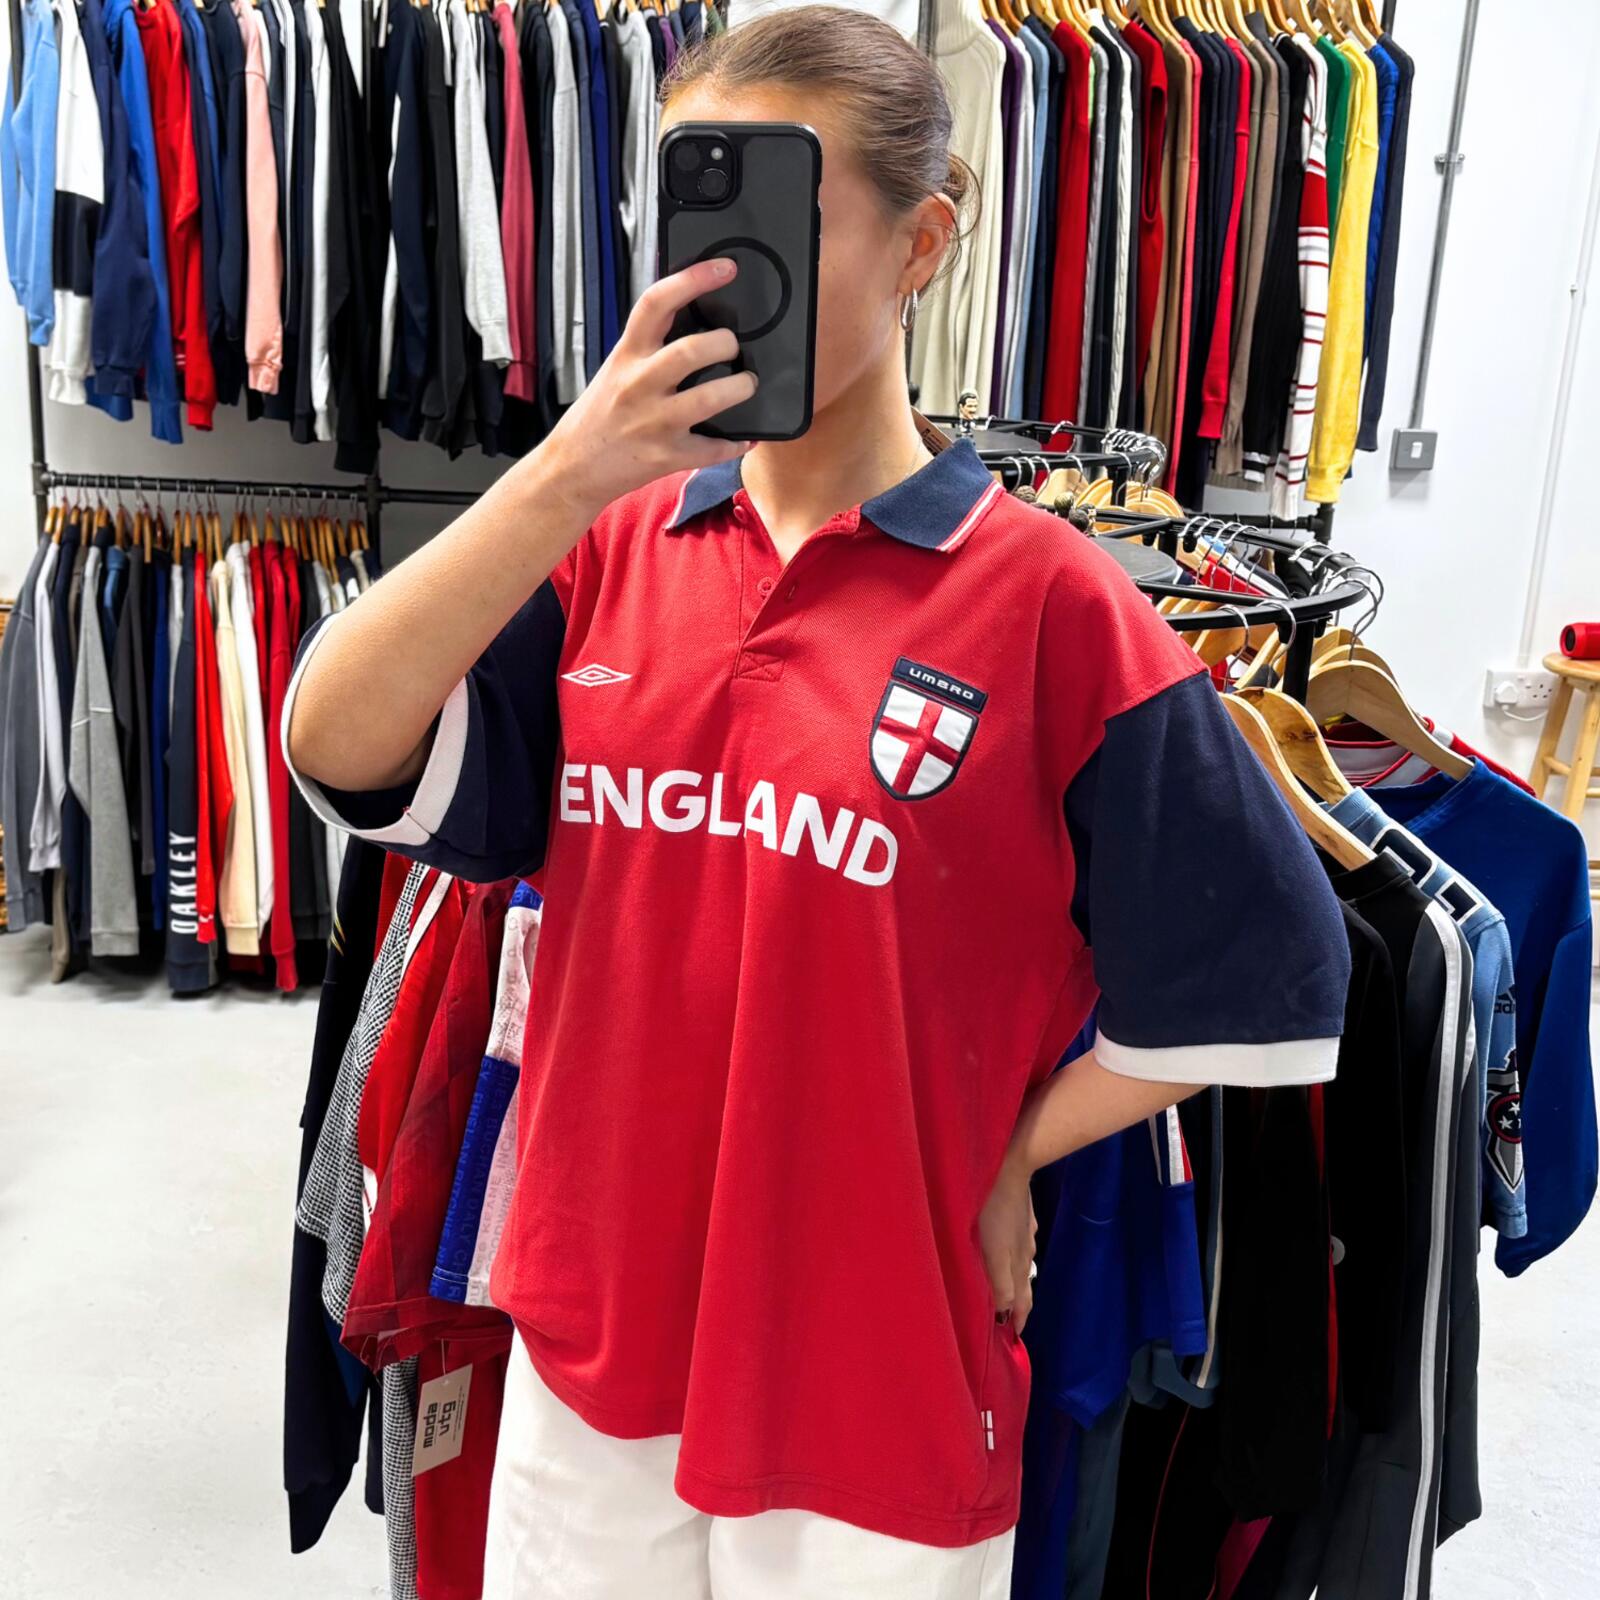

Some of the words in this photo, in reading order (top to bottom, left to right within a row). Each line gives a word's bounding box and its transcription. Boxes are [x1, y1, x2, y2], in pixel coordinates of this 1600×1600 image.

[560, 763, 898, 886] ENGLAND
[169, 831, 198, 933] OAKLEY
[423, 1402, 438, 1448] moda
